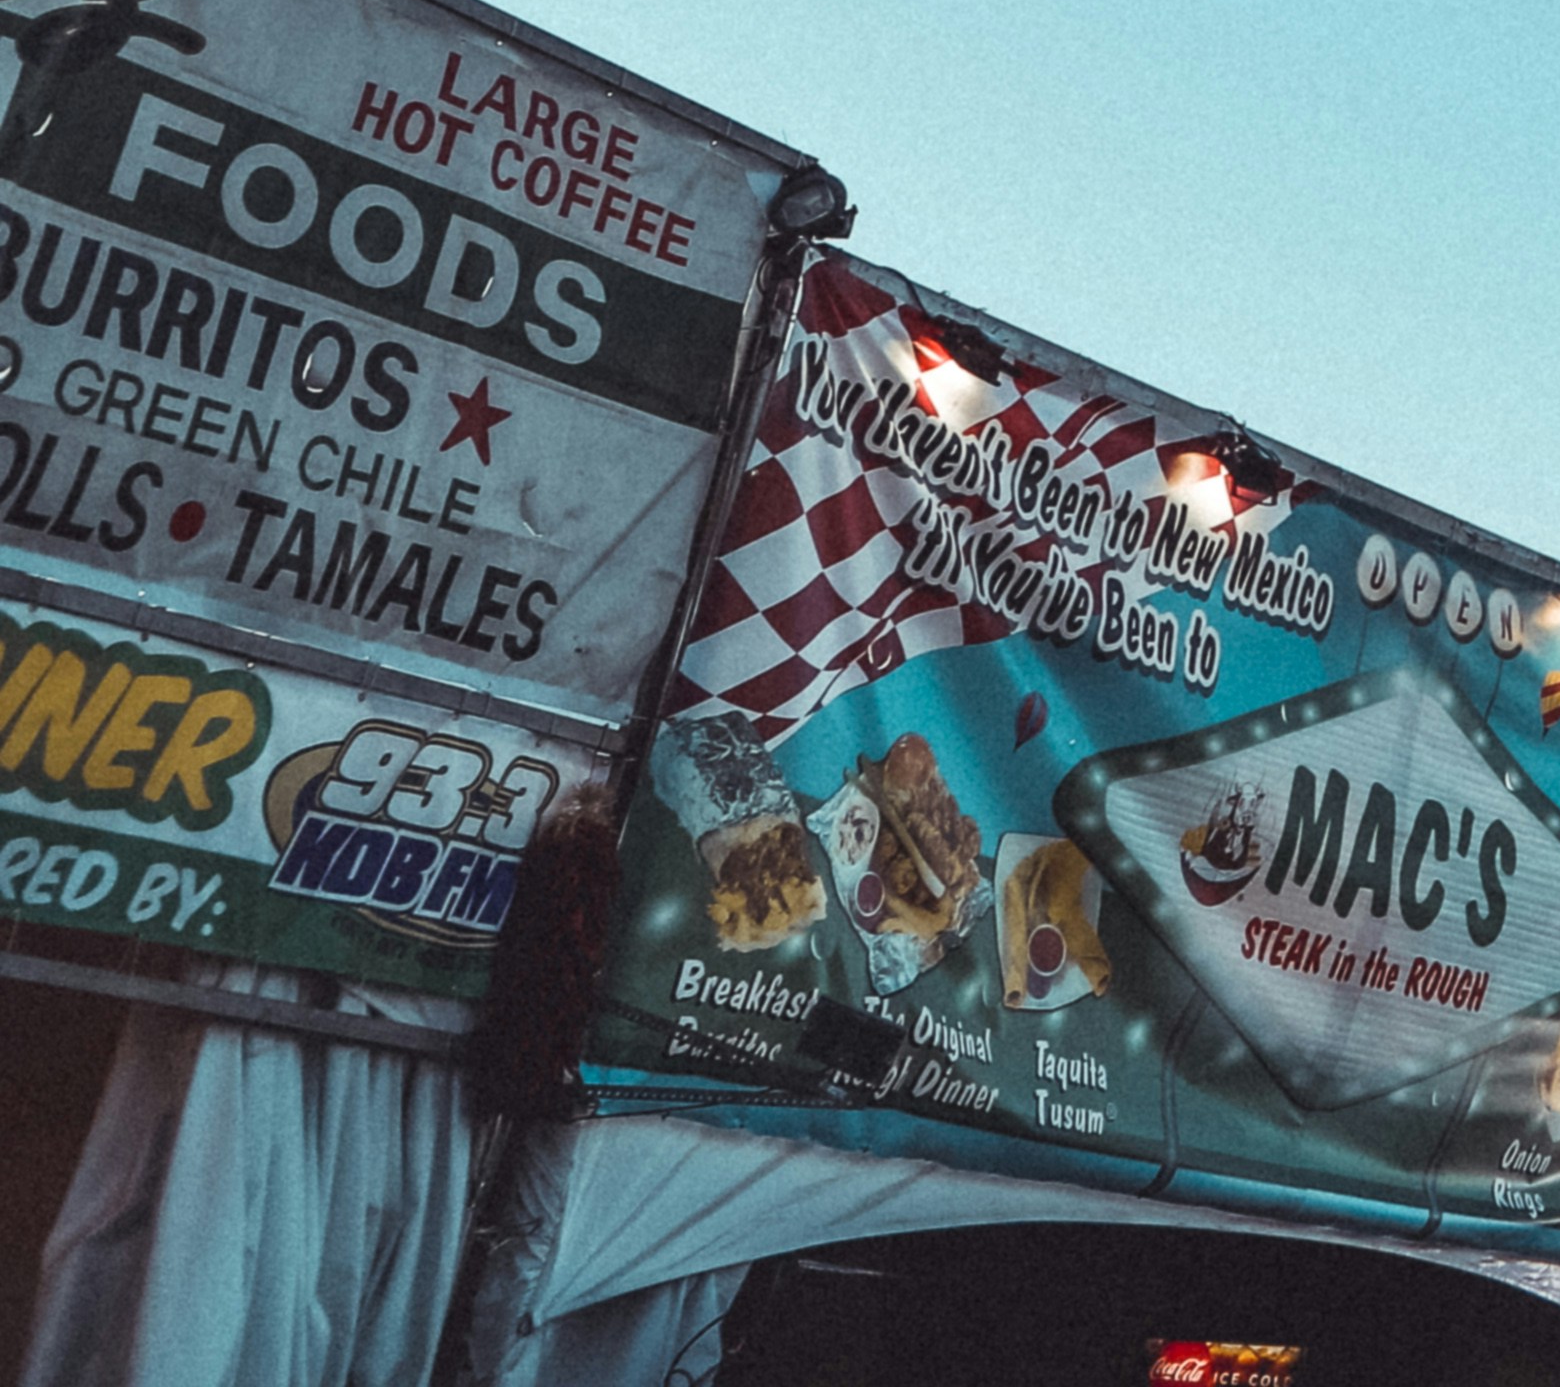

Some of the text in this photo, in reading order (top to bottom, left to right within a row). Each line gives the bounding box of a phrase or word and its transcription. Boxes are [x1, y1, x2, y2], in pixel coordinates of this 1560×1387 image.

[438, 51, 640, 183] LARGE
[351, 80, 697, 268] HOT COFFEE
[107, 91, 607, 365] FOODS
[54, 358, 282, 474] GREEN
[299, 434, 481, 535] CHILE
[799, 338, 867, 435] You
[1015, 443, 1102, 540] Been
[1106, 489, 1146, 557] to
[1150, 501, 1228, 587] New
[1226, 530, 1333, 626] Mexico
[225, 489, 559, 663] TAMALES
[1100, 575, 1176, 668] Been
[1185, 612, 1219, 685] to
[320, 724, 552, 851] 93.3
[126, 862, 227, 937] BY:
[1265, 764, 1517, 948] MAC'S
[675, 959, 820, 1022] Breakfast
[1241, 916, 1490, 1013] STEAK in the ROUGH
[913, 1005, 993, 1064] Original
[1035, 1039, 1108, 1091] Taquita
[912, 1058, 999, 1114] Dinner
[1035, 1088, 1105, 1135] Tusum
[1491, 1176, 1547, 1219] Rings
[1502, 1137, 1552, 1175] Onion
[1212, 1371, 1241, 1386] ICE
